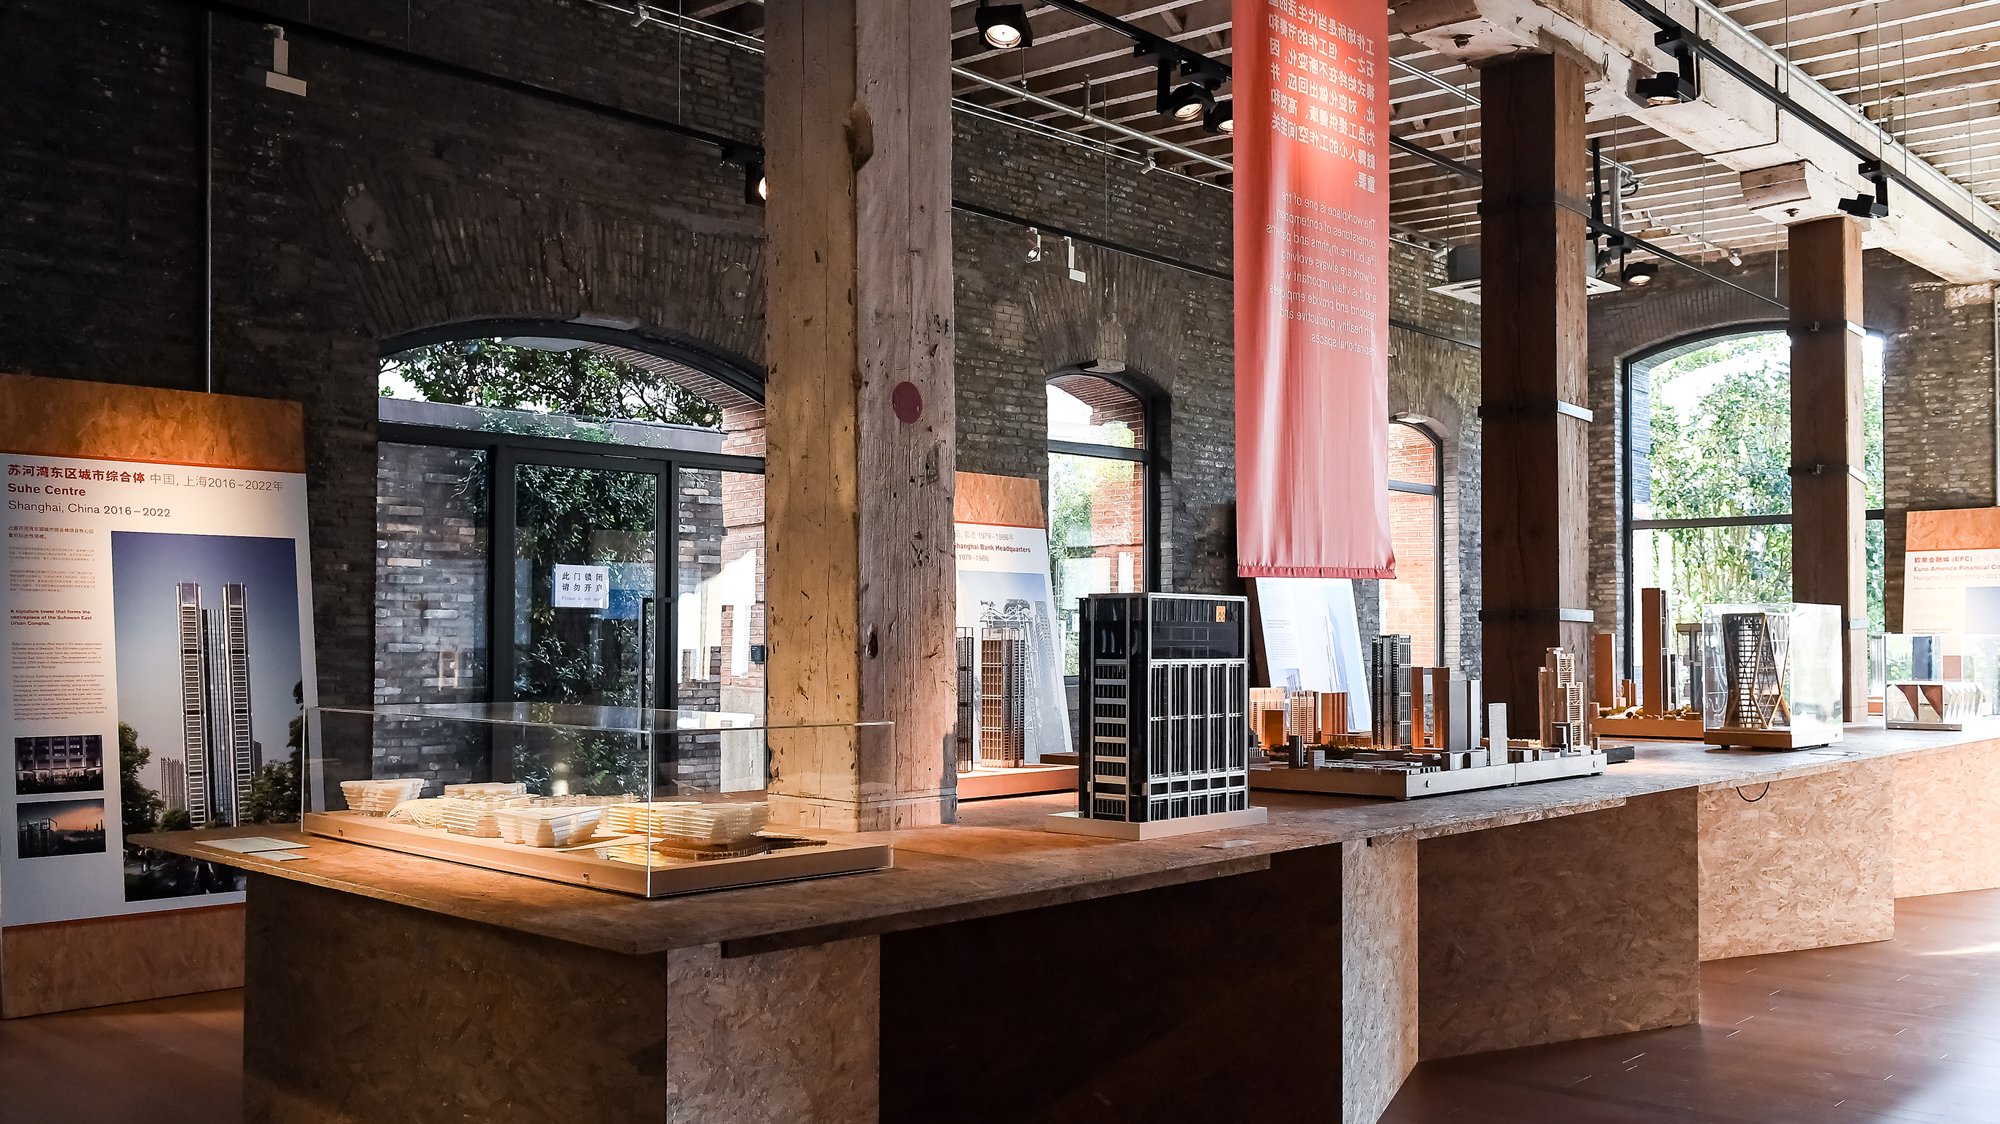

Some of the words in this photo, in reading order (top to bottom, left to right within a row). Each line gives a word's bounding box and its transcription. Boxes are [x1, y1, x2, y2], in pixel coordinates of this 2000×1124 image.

[8, 464, 145, 483] 苏河湾东区城市综合体
[8, 483, 40, 494] Suhe
[45, 485, 86, 497] Centre
[8, 500, 64, 513] Shanghai,
[68, 503, 100, 514] China
[996, 545, 1031, 553] Headquarters
